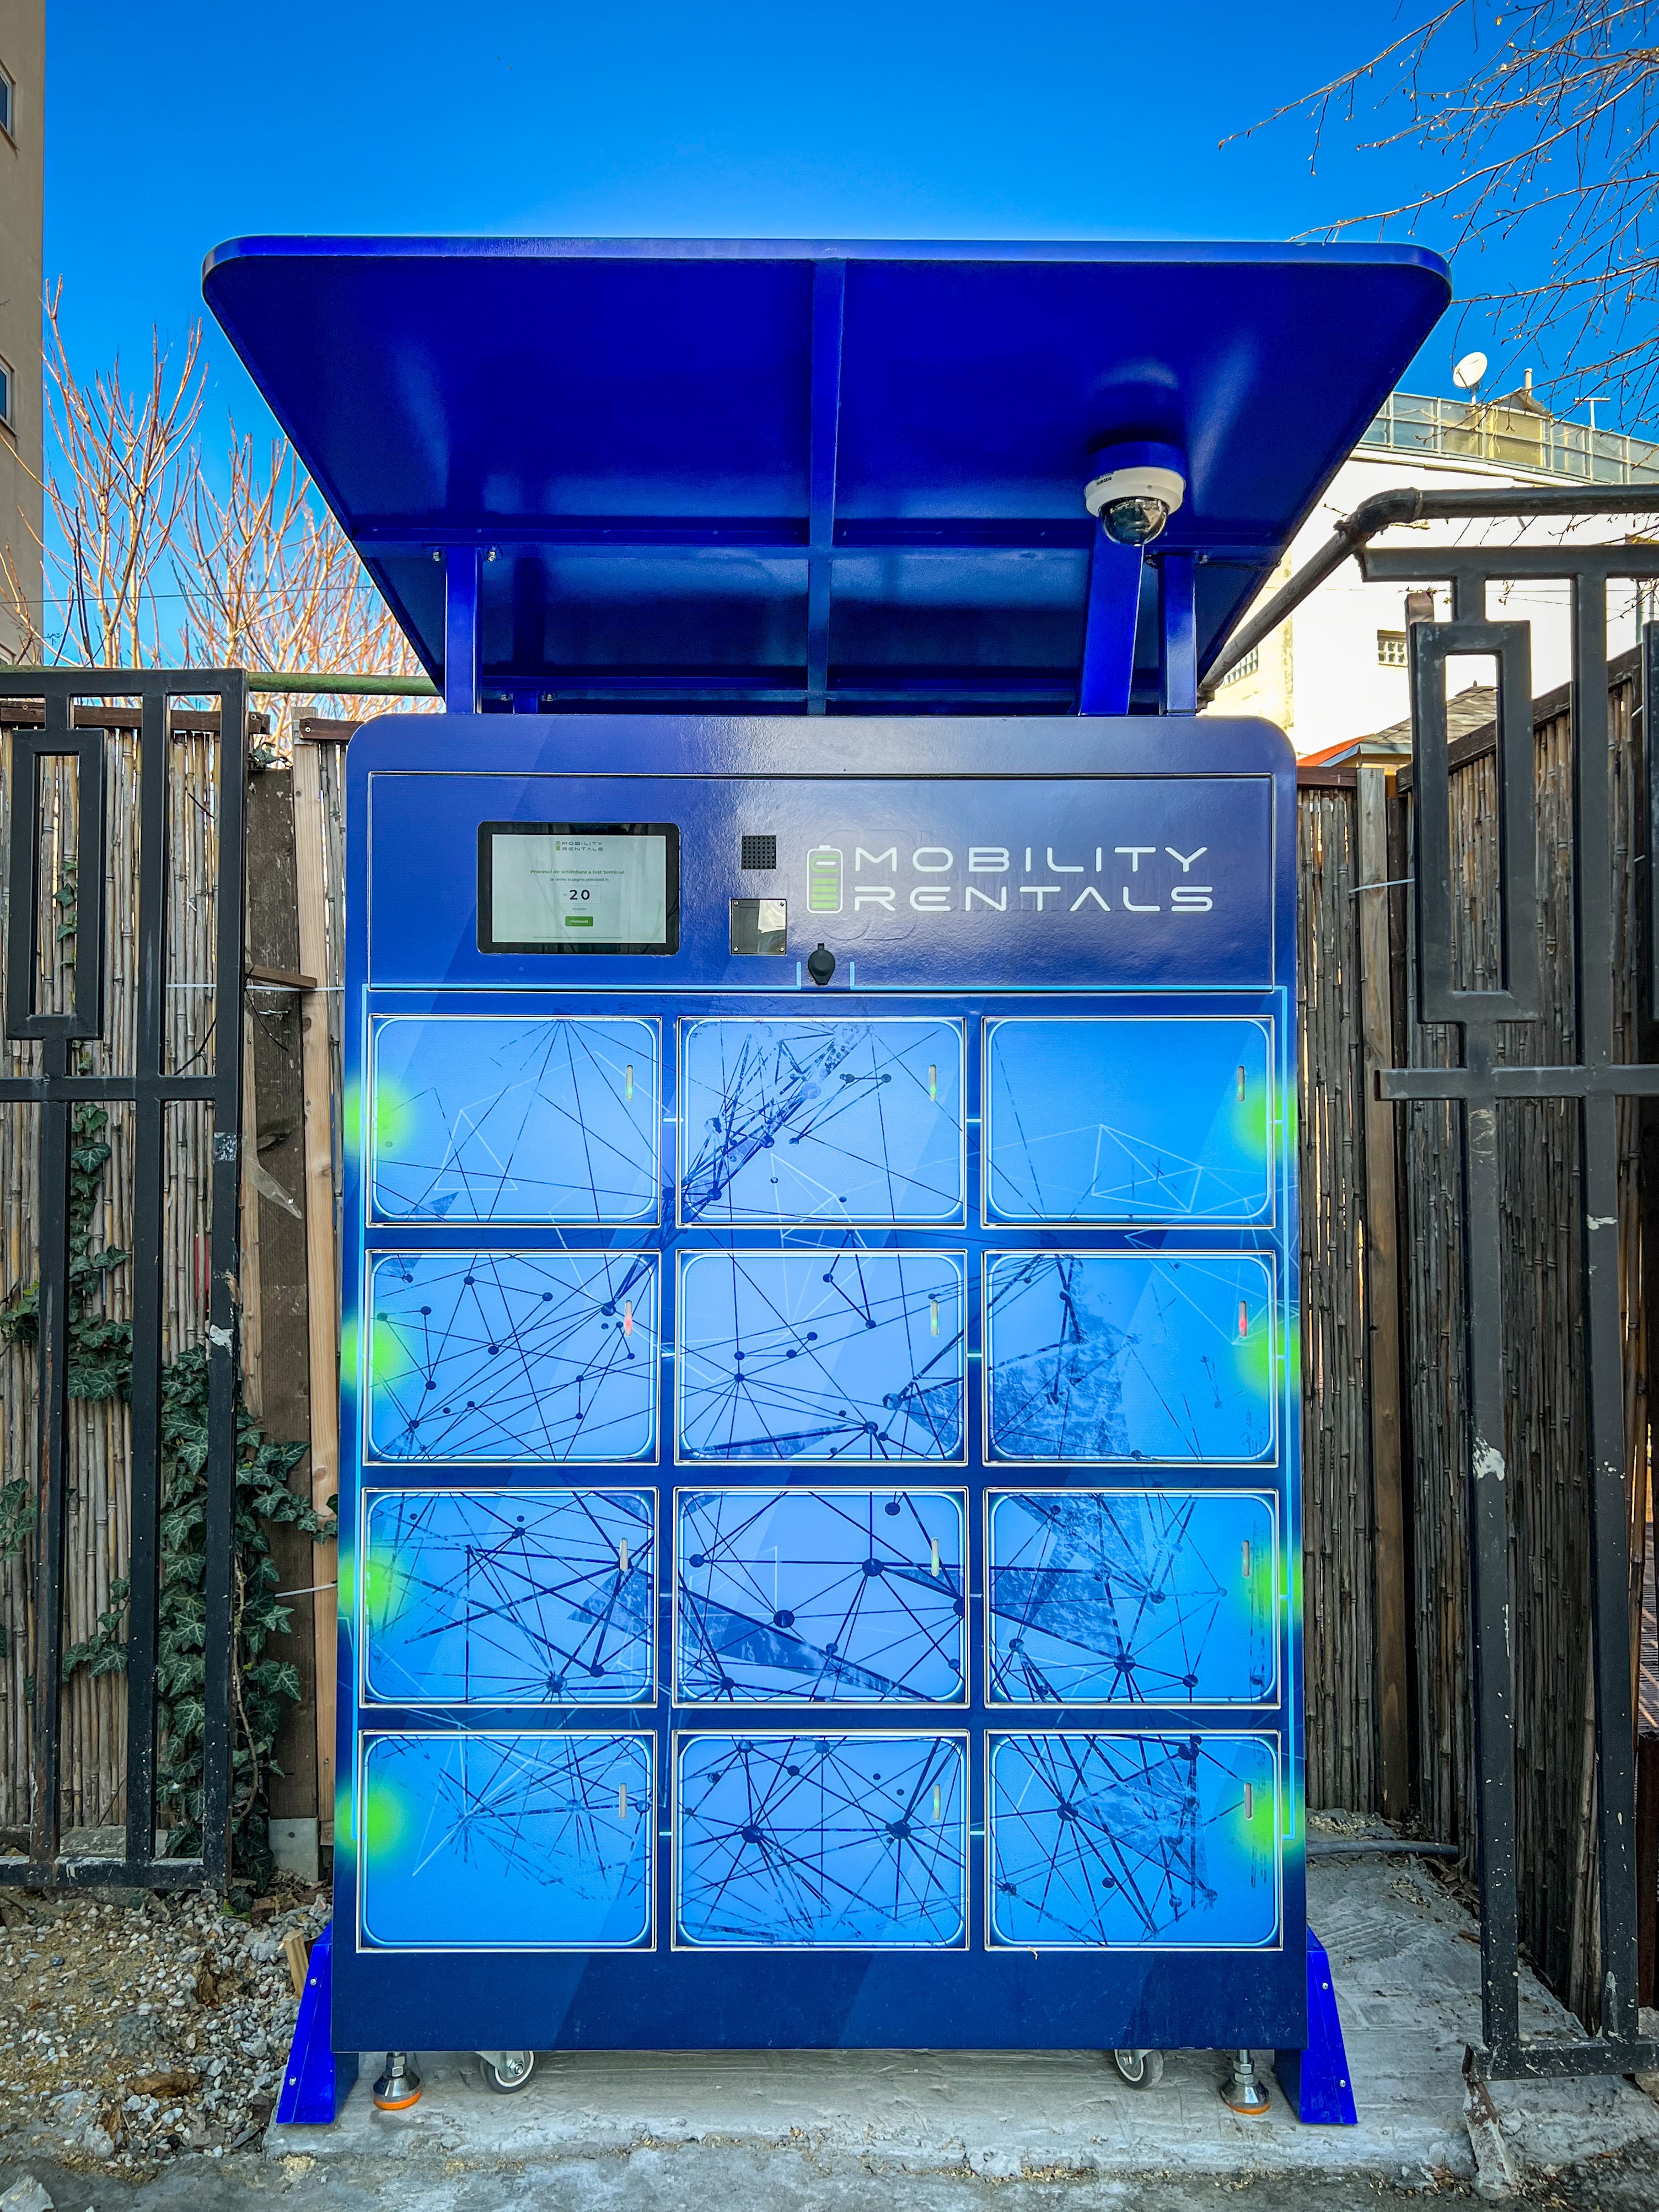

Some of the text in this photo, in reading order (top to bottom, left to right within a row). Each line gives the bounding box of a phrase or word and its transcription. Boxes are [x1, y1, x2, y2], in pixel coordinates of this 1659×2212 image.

[855, 847, 1207, 872] MOBILITY
[569, 889, 590, 900] 20
[855, 886, 1212, 911] RENTALS
